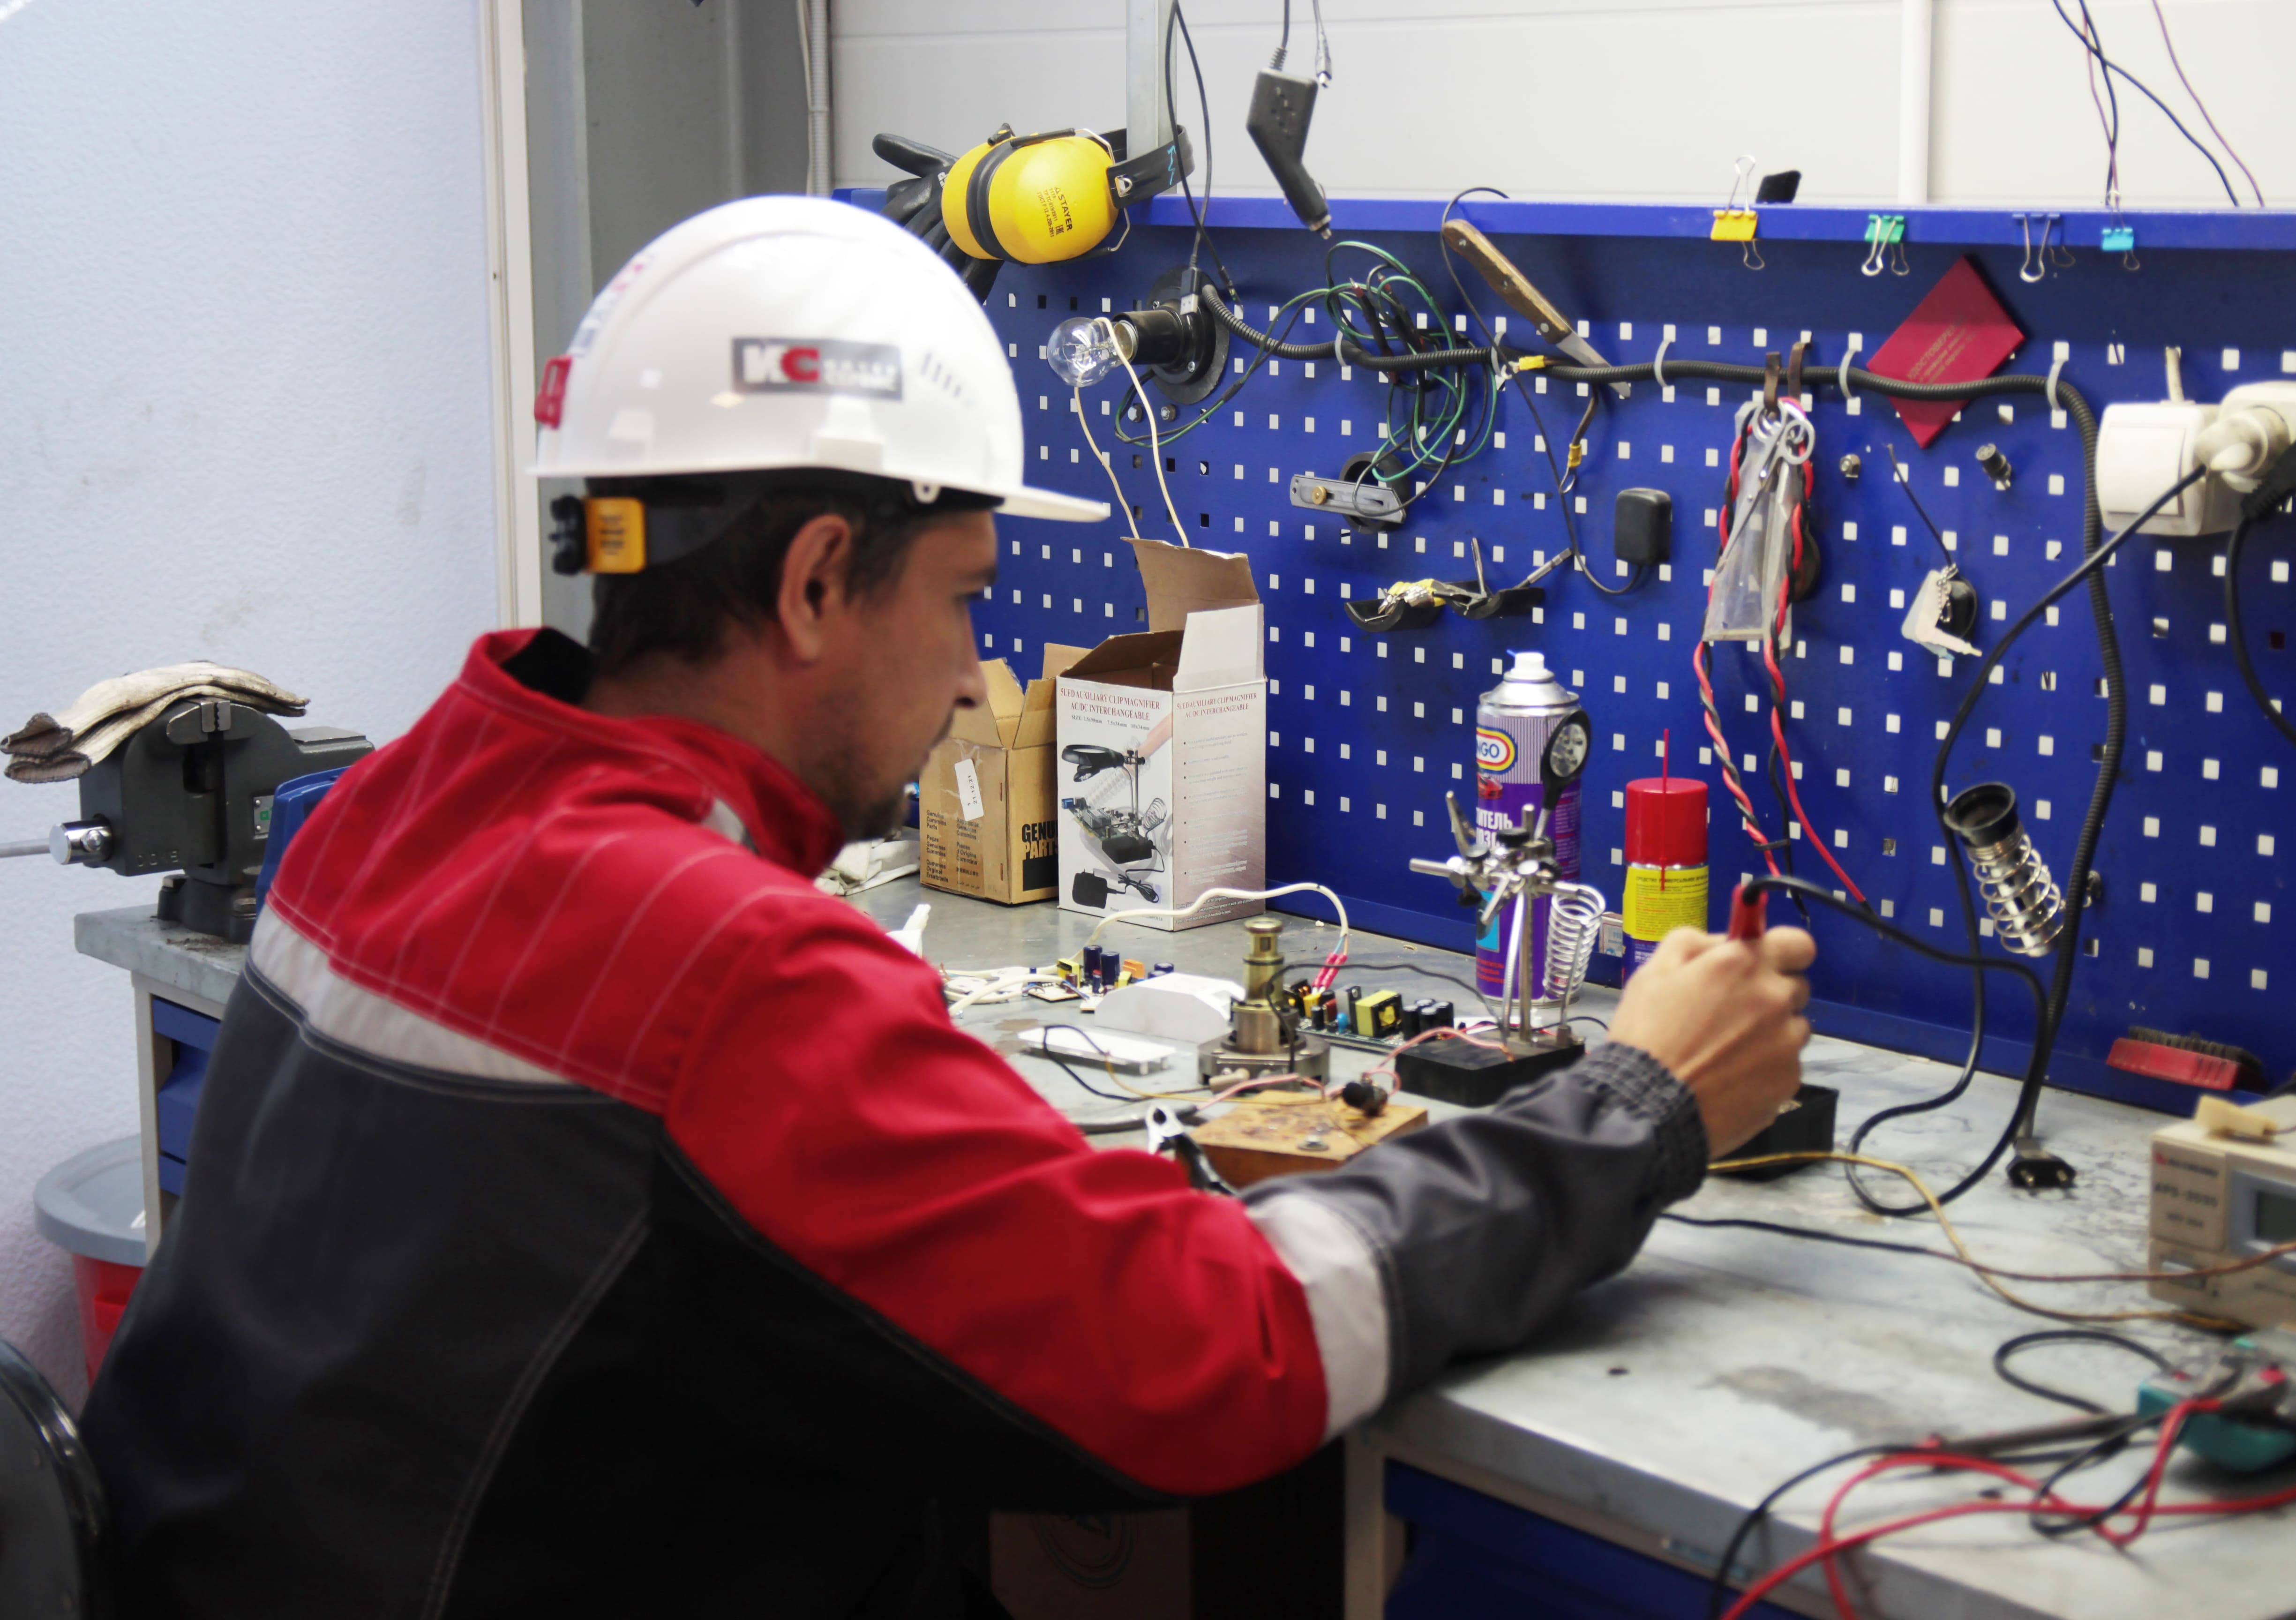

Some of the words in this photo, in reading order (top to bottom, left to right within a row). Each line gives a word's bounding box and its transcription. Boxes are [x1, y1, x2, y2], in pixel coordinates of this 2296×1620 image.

[1058, 194, 1073, 231] STAYER
[1061, 688, 1075, 698] 5LED
[1077, 691, 1108, 703] AUXILIARY
[1109, 695, 1124, 704] CLIP
[1125, 697, 1160, 710] MAGNIFIER
[1190, 698, 1216, 709] AUXILIARY
[1229, 692, 1257, 702] MAGNIFIER
[1089, 705, 1150, 721] INTERCHANGEABLE
[1201, 703, 1249, 716] INTERCHANGEABLE
[926, 817, 947, 826] Cummins
[956, 830, 977, 840] Cummins
[1022, 821, 1058, 843] GENU
[926, 848, 946, 857] Cummins
[926, 859, 946, 869] Cummins
[956, 855, 977, 865] Cummins
